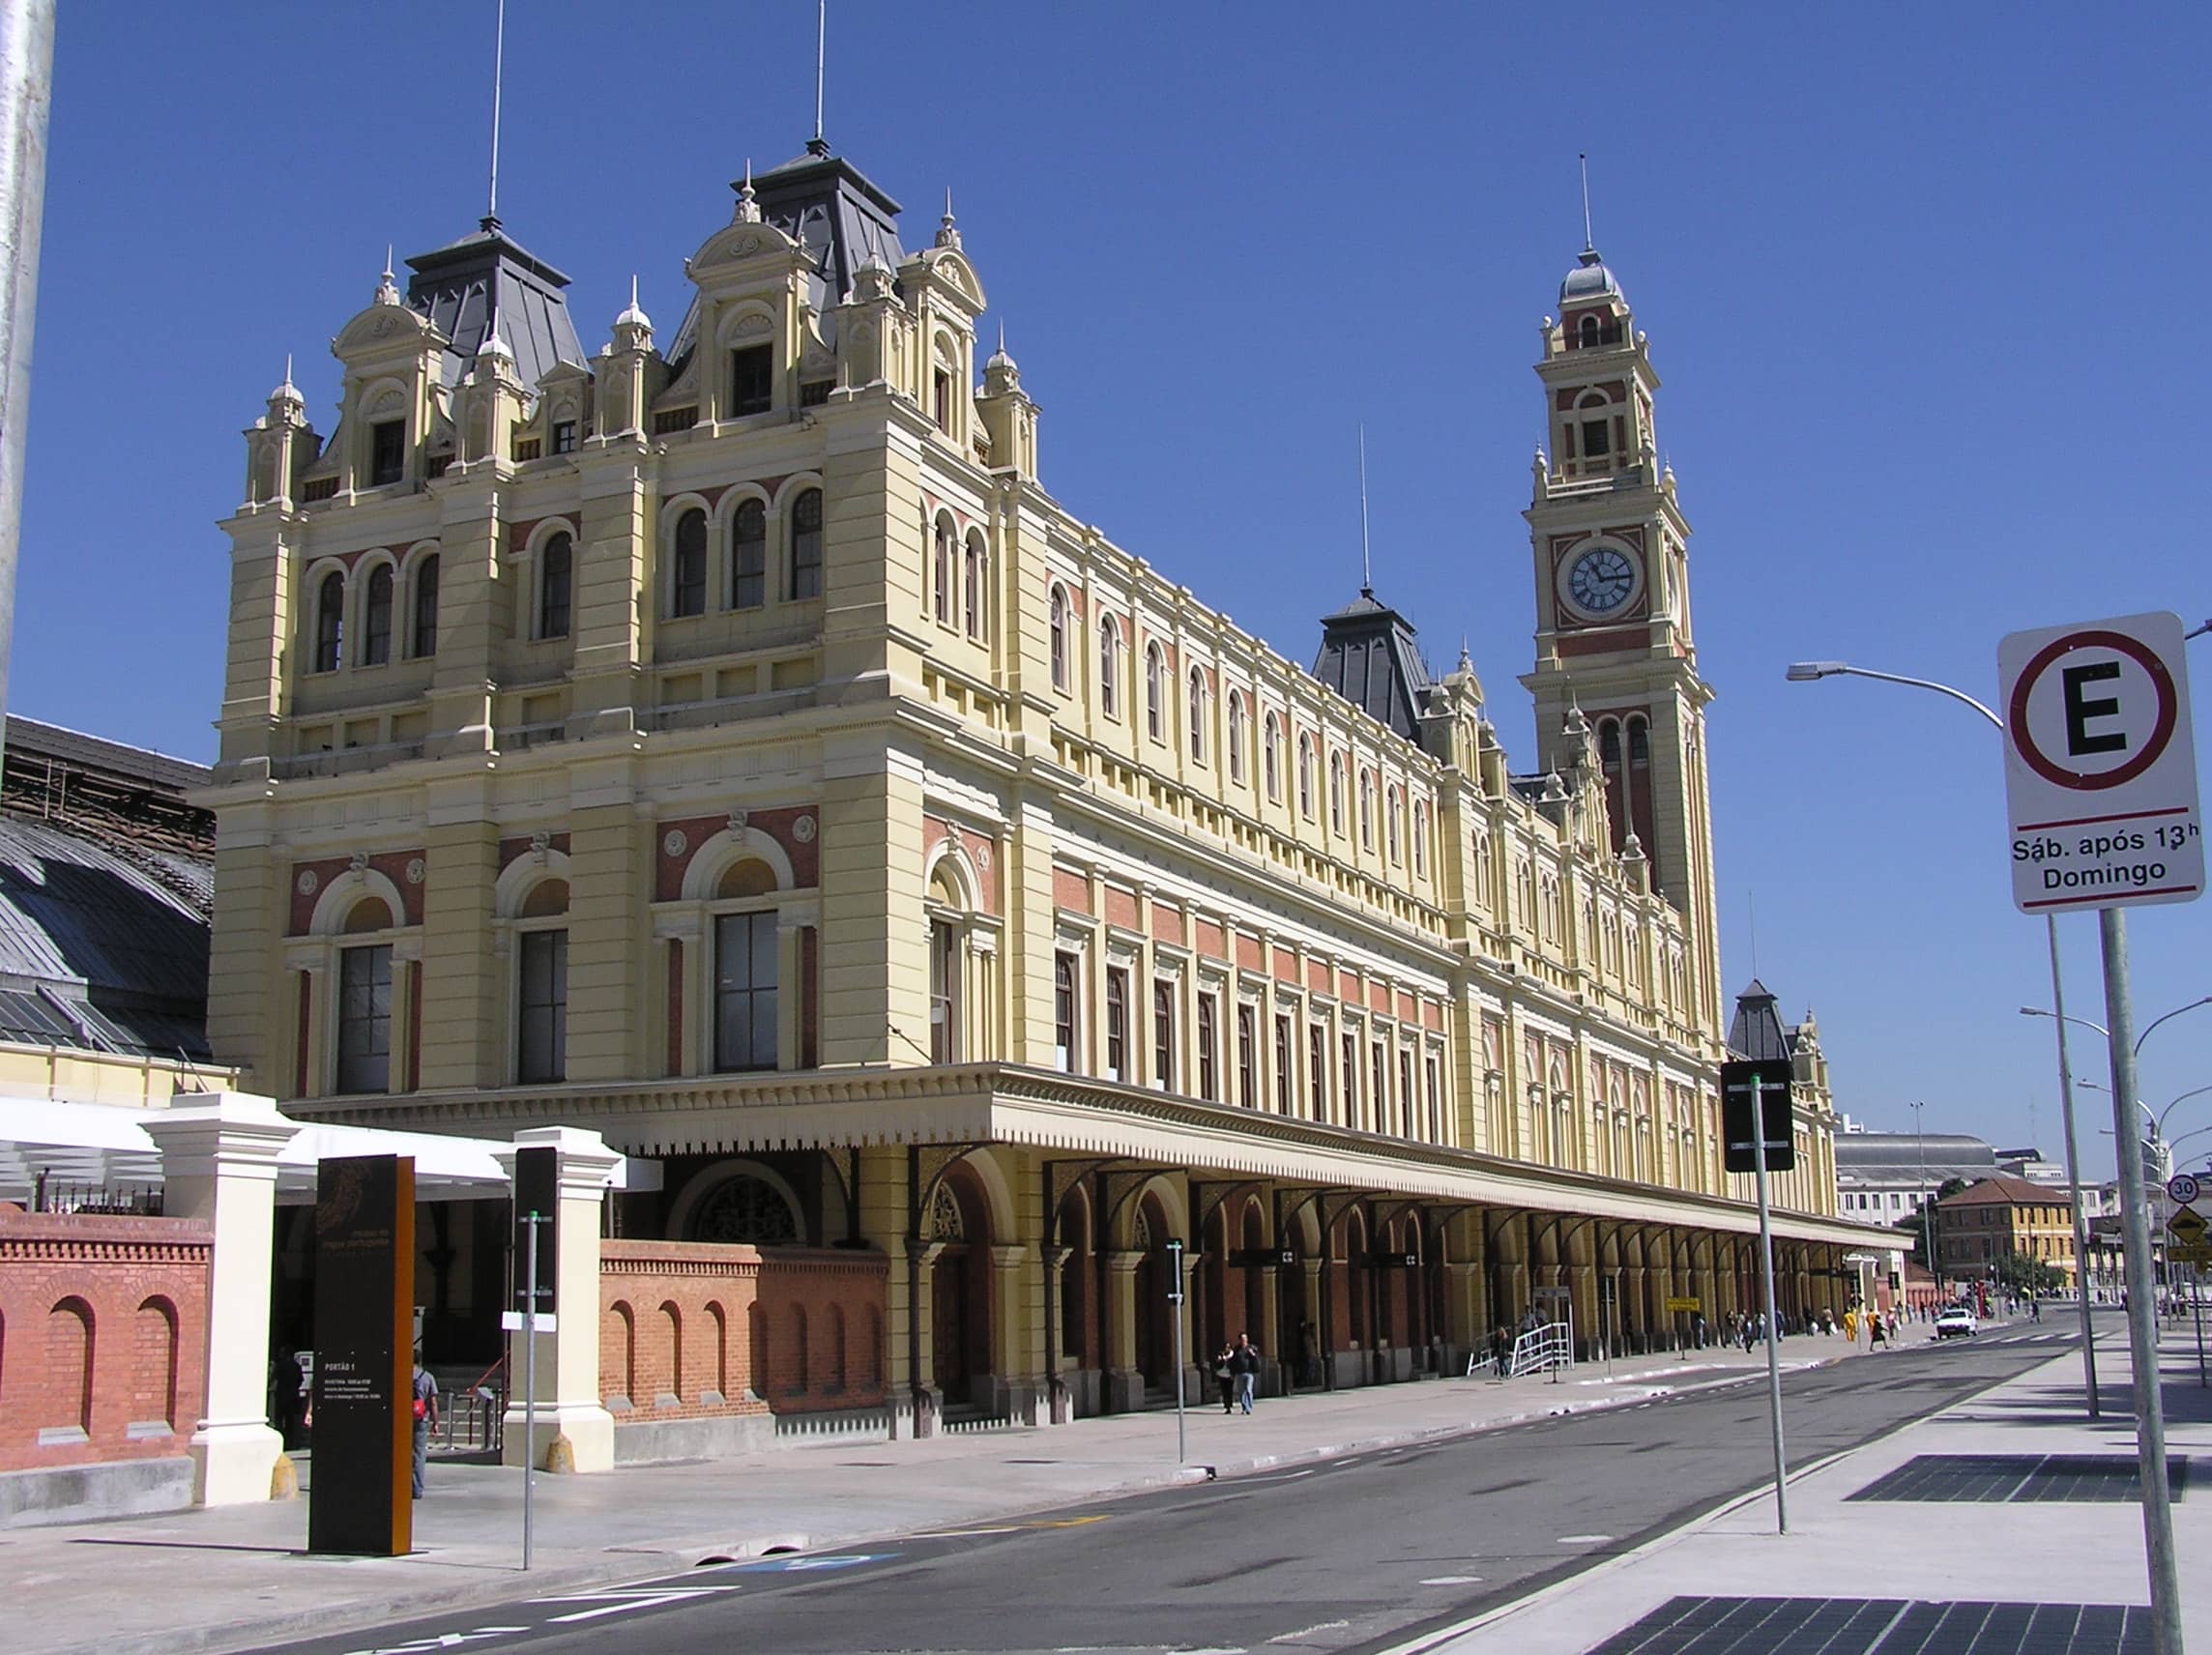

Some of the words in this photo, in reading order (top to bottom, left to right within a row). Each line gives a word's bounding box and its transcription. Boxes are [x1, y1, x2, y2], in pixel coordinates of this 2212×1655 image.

[2062, 661, 2127, 756] E
[2012, 837, 2070, 861] Sáb.
[2079, 829, 2144, 858] após
[2043, 862, 2167, 889] Domingo
[2174, 1181, 2193, 1194] 30
